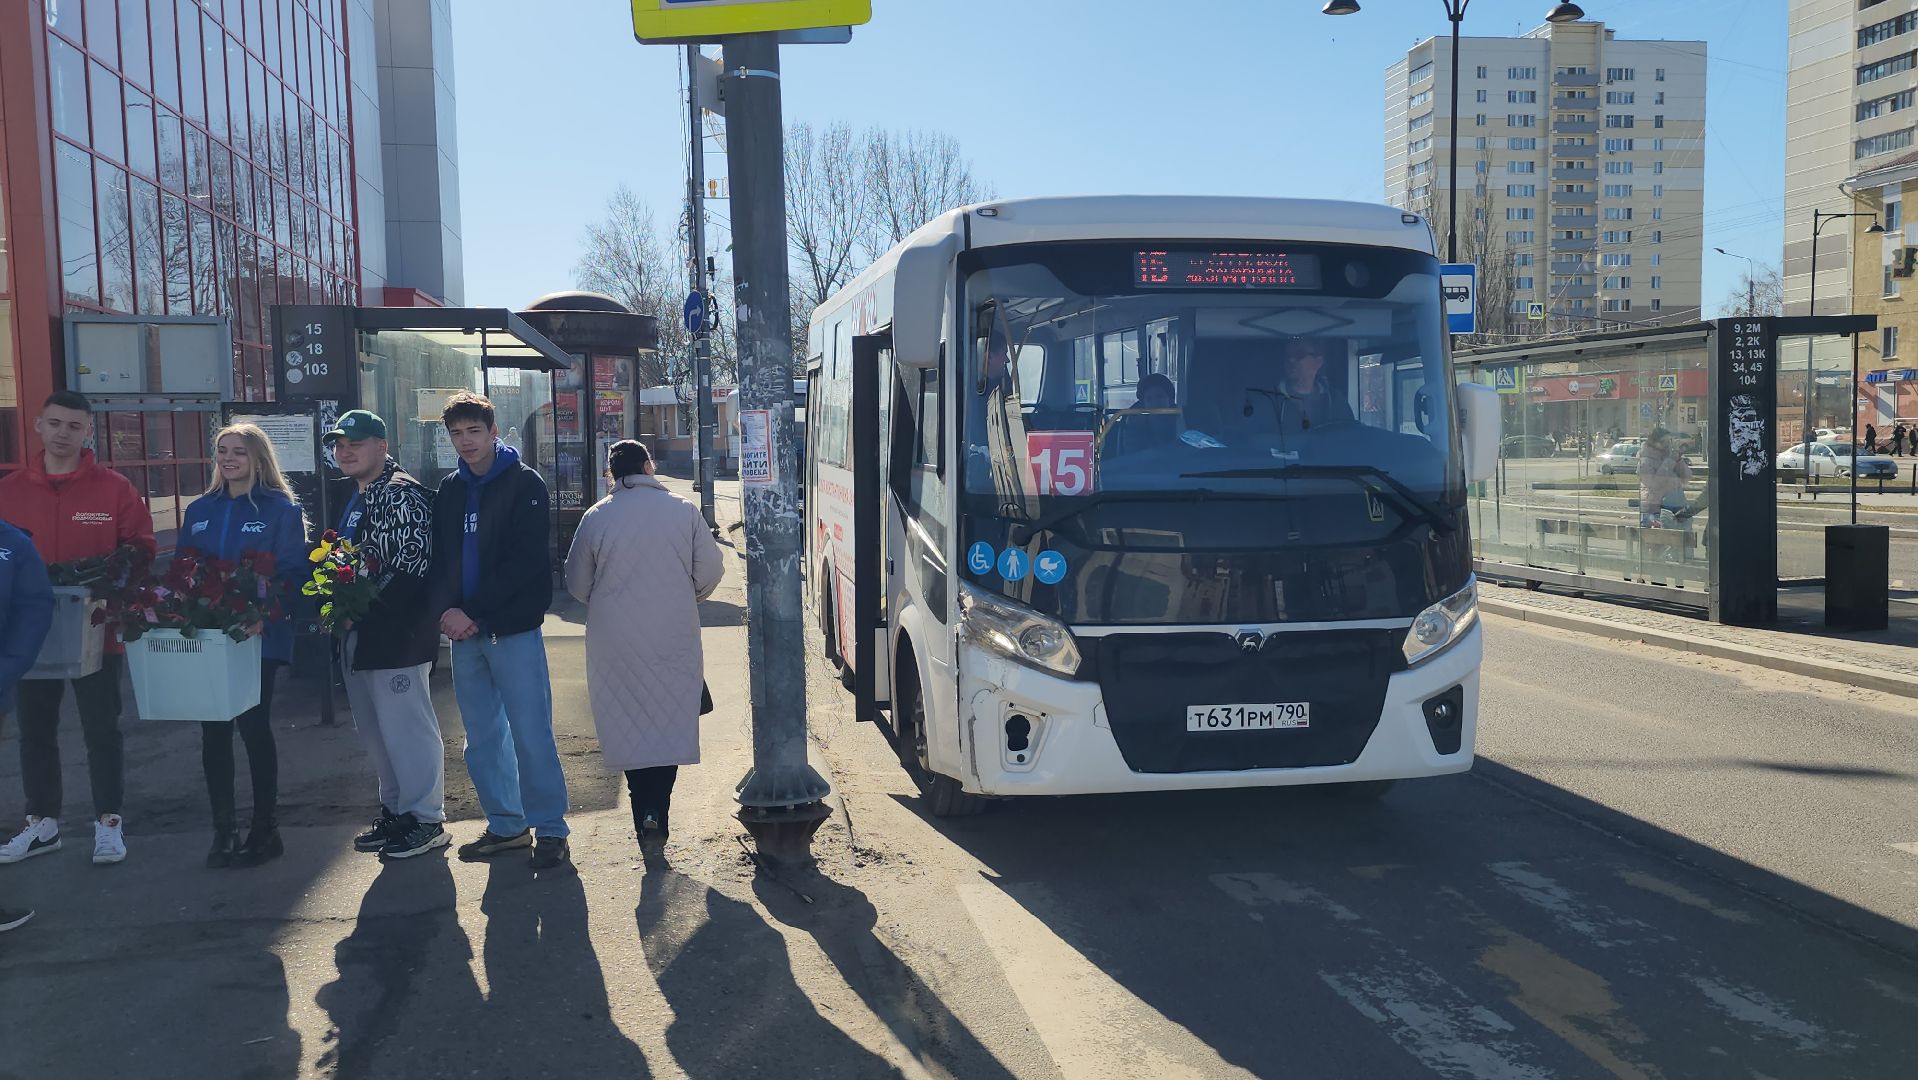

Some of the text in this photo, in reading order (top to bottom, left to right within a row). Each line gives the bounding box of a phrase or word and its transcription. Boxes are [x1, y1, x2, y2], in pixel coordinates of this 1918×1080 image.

[305, 323, 322, 335] 15
[1734, 323, 1743, 334] 9,
[1735, 336, 1745, 347] 2,
[306, 343, 323, 355] 18
[1730, 350, 1744, 360] 13,
[303, 363, 328, 375] 103
[1732, 362, 1762, 373] 34, 45
[1739, 375, 1757, 385] 104
[742, 460, 768, 469] АЙТИ
[1031, 448, 1086, 496] 15
[1276, 704, 1305, 720] 790
